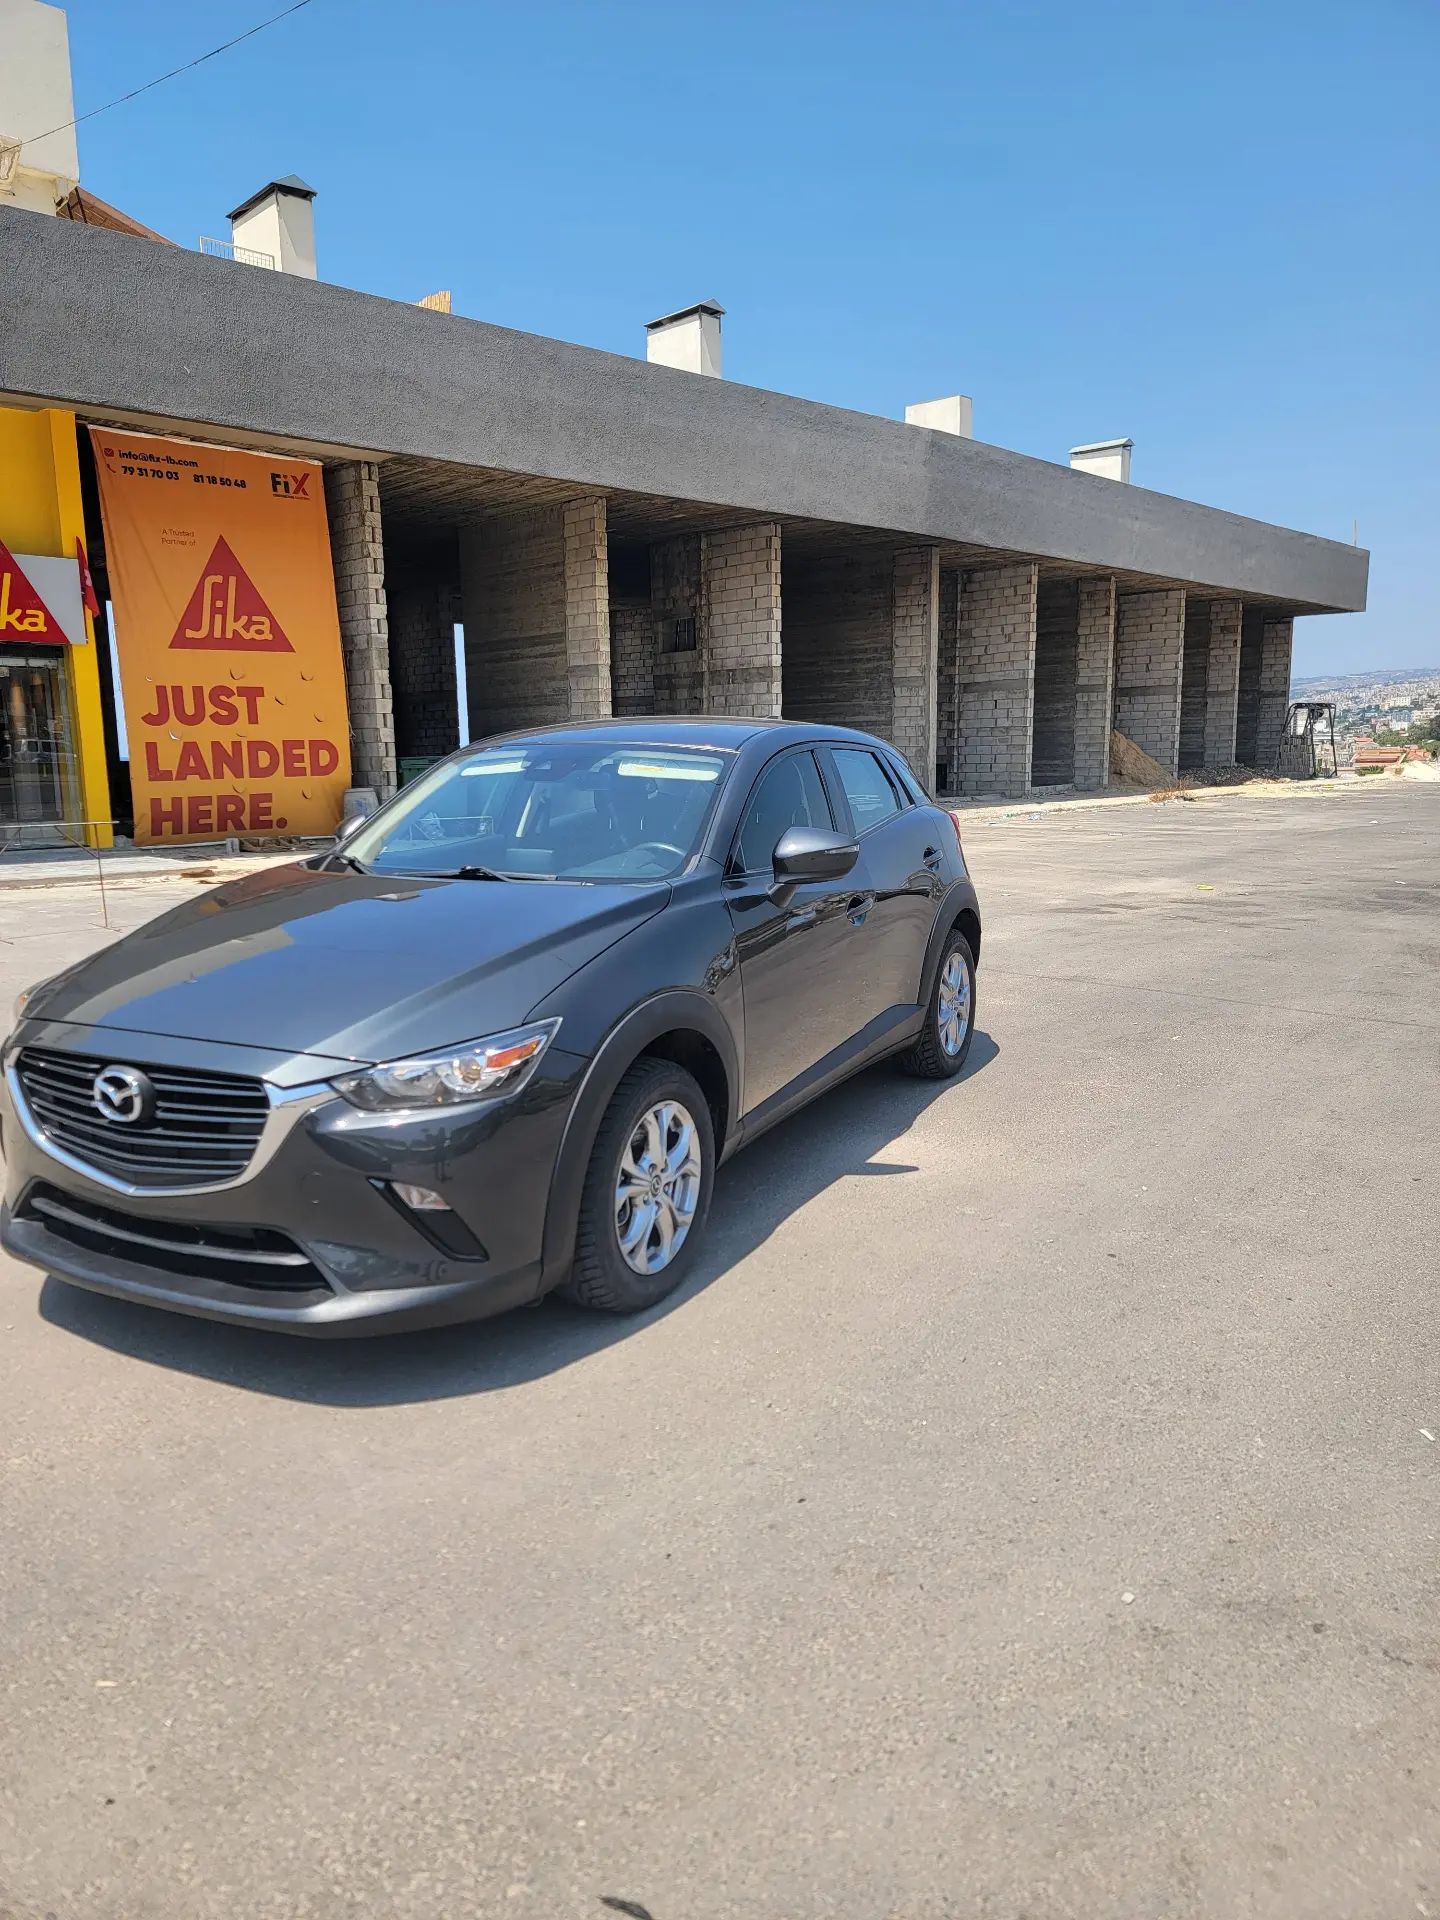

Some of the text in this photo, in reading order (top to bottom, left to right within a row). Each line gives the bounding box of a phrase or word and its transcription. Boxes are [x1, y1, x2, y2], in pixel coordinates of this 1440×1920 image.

[118, 449, 199, 468] info@fix-lb.com
[121, 465, 179, 481] 79 31 70 03
[193, 473, 247, 488] 81 18 50 48
[161, 537, 187, 546] Partner
[185, 574, 274, 641] Sika
[140, 685, 265, 727] JUST
[144, 739, 340, 782] LANDED
[149, 792, 288, 837] HERE.
